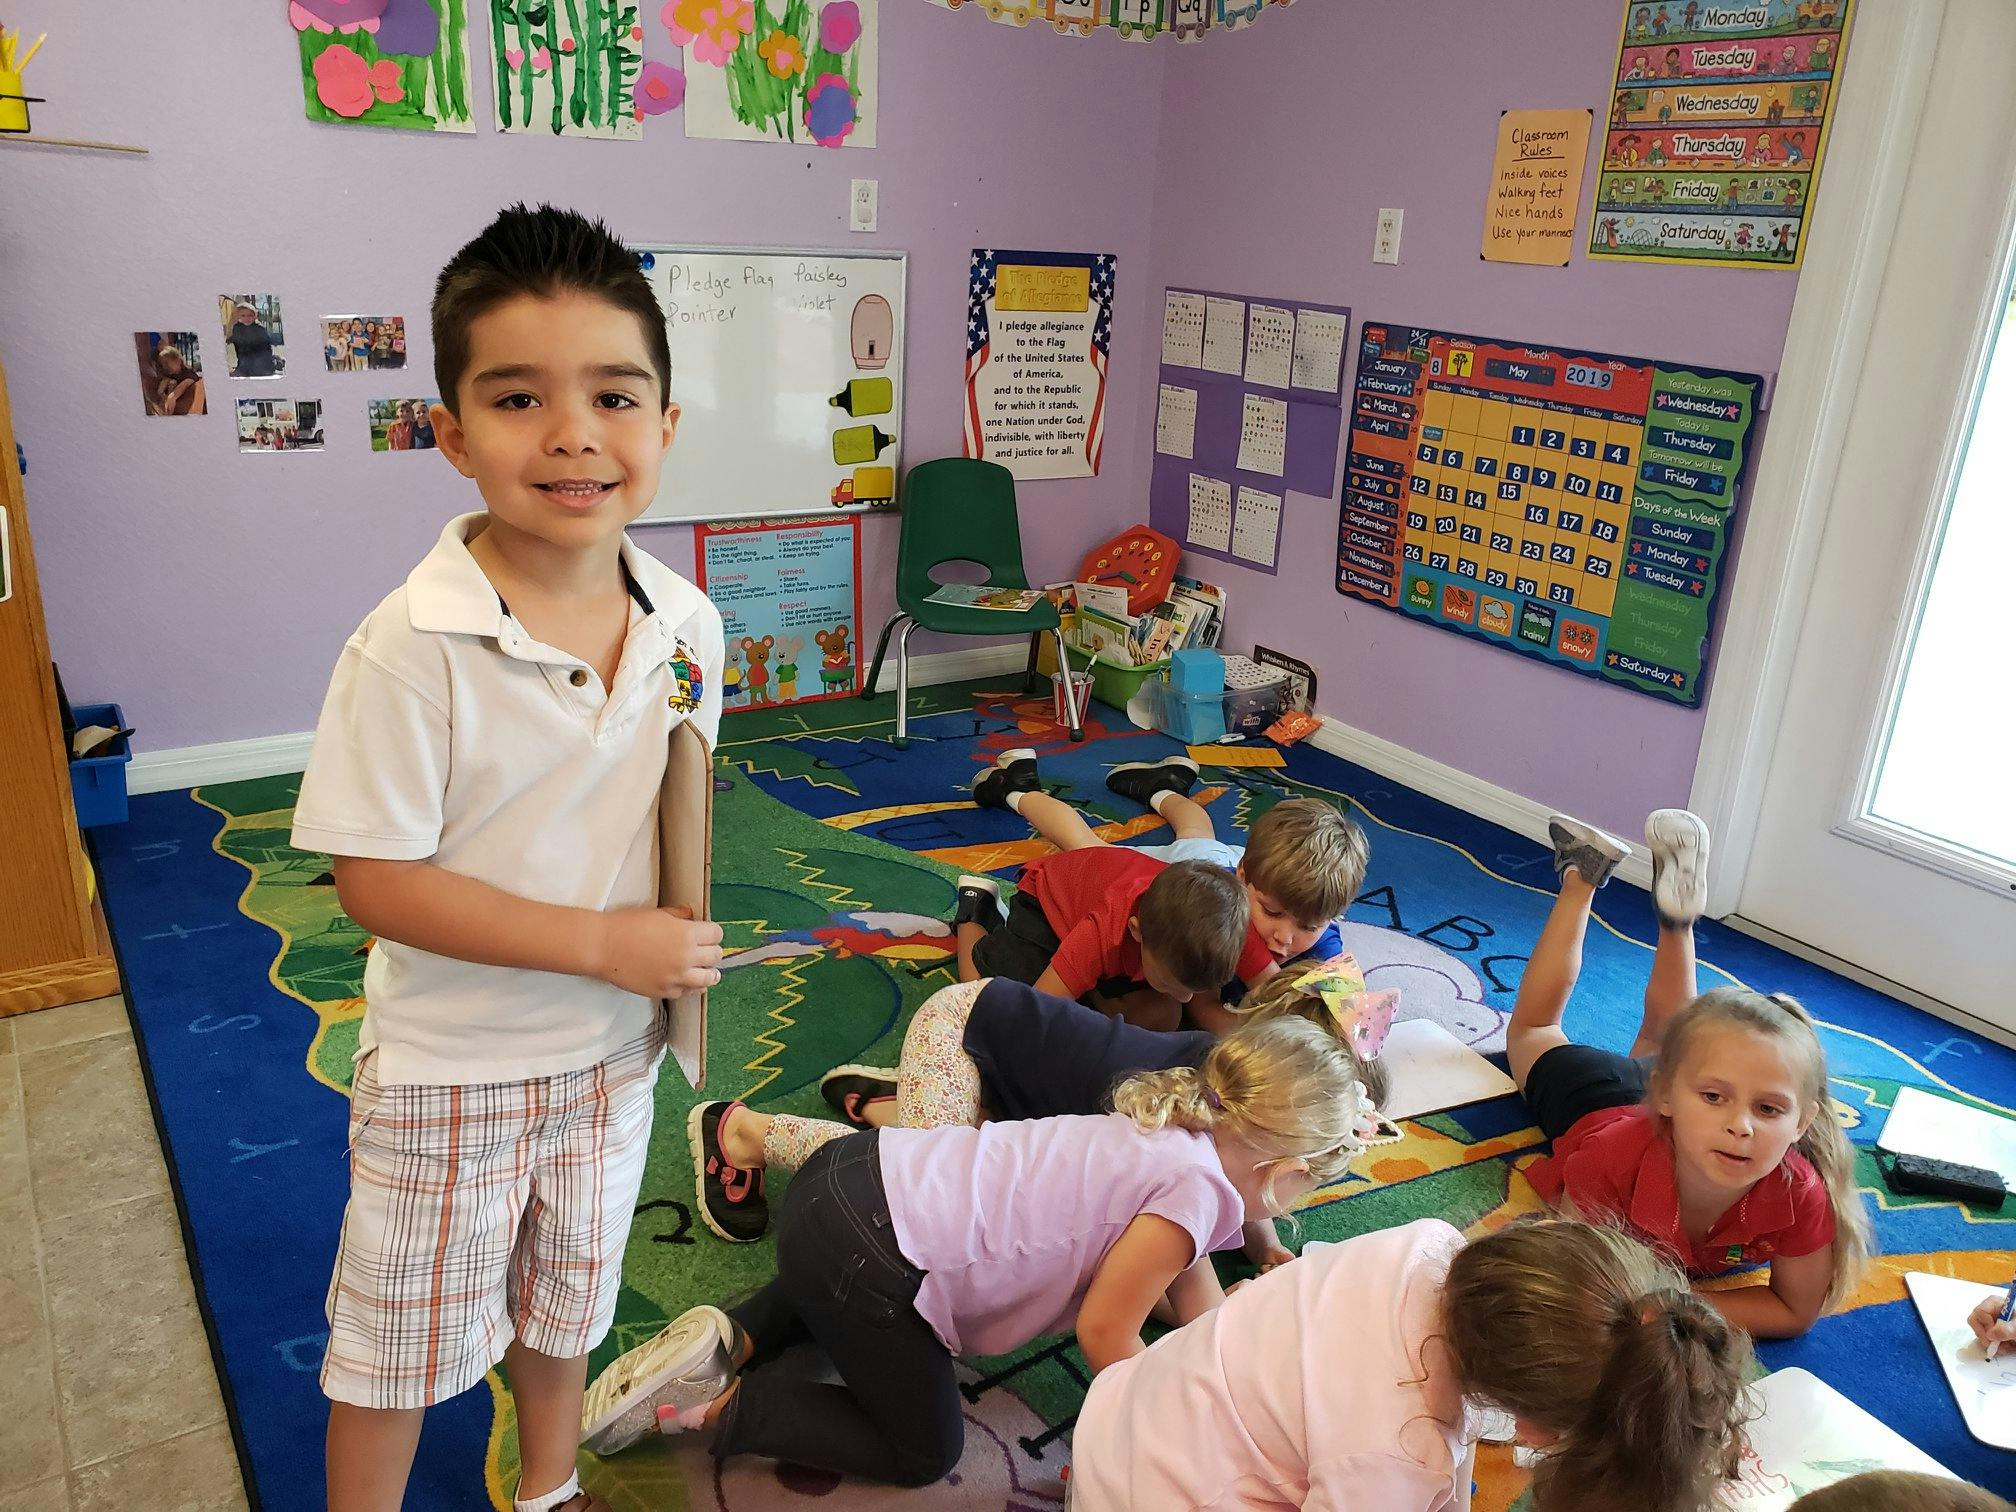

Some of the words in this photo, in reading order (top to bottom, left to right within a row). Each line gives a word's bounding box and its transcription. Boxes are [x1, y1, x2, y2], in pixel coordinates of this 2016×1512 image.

[1704, 9, 1766, 27] Monday
[1693, 50, 1754, 67] Tuesday
[1677, 96, 1759, 114] Wednesday
[1512, 129, 1568, 143] Classroom
[1520, 144, 1552, 158] Rules
[1675, 137, 1744, 156] Thursday
[1501, 168, 1532, 180] Inside
[1539, 168, 1567, 178] voices
[1499, 186, 1535, 204] Walking
[1540, 183, 1563, 198] feet
[1673, 182, 1719, 201] Friday
[1496, 208, 1520, 218] Nice
[1526, 206, 1563, 219] hands
[1493, 226, 1511, 239] Use
[1517, 229, 1536, 244] your
[1661, 222, 1725, 244] Saturday
[670, 265, 731, 298] Pledge
[794, 263, 846, 287] Paisley
[1009, 270, 1031, 284] The
[1036, 271, 1078, 288] Pledge
[1003, 289, 1016, 302] of
[1020, 289, 1083, 305] Allegiance
[666, 302, 736, 327] Pointer
[999, 321, 1003, 330] I
[1006, 321, 1036, 333] pledge
[1040, 321, 1084, 333] allegiance
[1016, 338, 1025, 346] to
[1029, 338, 1043, 346] the
[1047, 338, 1065, 348] Flag
[1450, 338, 1476, 350] Season
[995, 354, 1003, 362] of
[1007, 353, 1022, 362] the
[1025, 353, 1054, 362] United
[1058, 354, 1084, 362] States
[1524, 348, 1550, 360] Month
[1013, 369, 1022, 378] of
[1026, 370, 1063, 379] America,
[1375, 361, 1406, 375] January
[1431, 360, 1440, 374] 8
[1509, 365, 1529, 380] May
[1608, 360, 1626, 372] Year
[1566, 367, 1611, 387] 2019
[994, 386, 1011, 395] and
[1015, 386, 1023, 394] to
[1026, 386, 1041, 394] the
[1044, 385, 1081, 396] Republic
[1368, 378, 1402, 394] February
[1668, 378, 1712, 395] Yesterday
[1713, 387, 1732, 396] was
[995, 402, 1007, 411] for
[1011, 401, 1036, 410] which
[1039, 401, 1045, 410] it
[1049, 401, 1079, 411] stands,
[1374, 399, 1398, 413] March
[1433, 382, 1452, 392] Sunday
[1460, 387, 1480, 397] Monday
[1489, 391, 1510, 403] Tuesday
[1514, 396, 1545, 408] Wednesday
[1547, 402, 1574, 413] Thursday
[1584, 408, 1603, 418] Friday
[1613, 414, 1642, 425] Saturday
[1668, 395, 1728, 418] Wednesday
[1006, 417, 1034, 426] Nation
[1038, 416, 1063, 425] under
[1067, 415, 1085, 425] God,
[1371, 420, 1389, 433] April
[1676, 417, 1700, 432] Today
[1703, 422, 1710, 432] is
[985, 432, 1030, 443] indivisible,
[1035, 432, 1054, 441] with
[1058, 431, 1085, 441] liberty
[1520, 429, 1526, 442] 1
[1547, 433, 1556, 447] 2
[1578, 442, 1587, 455] 3
[1611, 448, 1621, 462] 4
[1663, 431, 1716, 454] Thursday
[996, 448, 1012, 457] and
[1015, 448, 1043, 459] justice
[1047, 447, 1058, 456] for
[1062, 446, 1074, 455] all.
[1648, 450, 1693, 466] Tomorrow
[1695, 460, 1710, 469] will
[1712, 462, 1723, 472] be
[1366, 459, 1384, 472] June
[1423, 447, 1432, 461] 5
[1448, 452, 1456, 465] 6
[1481, 459, 1491, 472] 7
[1512, 466, 1521, 480] 8
[1540, 471, 1548, 485] 9
[1568, 478, 1585, 494] 10
[1600, 484, 1615, 501] 11
[1364, 480, 1380, 492] July
[1665, 468, 1698, 488] Friday
[1357, 495, 1384, 511] August
[1412, 476, 1426, 493] 12
[1440, 486, 1453, 501] 13
[1468, 492, 1483, 508] 14
[1501, 484, 1516, 499] 15
[1528, 507, 1544, 523] 16
[1562, 513, 1579, 530] 17
[1595, 522, 1613, 540] 18
[1634, 496, 1661, 514] Days
[1662, 507, 1672, 516] of
[1674, 508, 1688, 519] the
[1690, 508, 1720, 527] Week
[1349, 512, 1389, 532] September
[776, 530, 824, 540] Responsibility
[1351, 533, 1382, 549] October
[1652, 523, 1693, 543] Sunday
[1410, 514, 1423, 529] 19
[1438, 518, 1454, 532] 20
[1462, 527, 1476, 542] 21
[1491, 535, 1509, 551] 22
[1522, 543, 1540, 559] 23
[1552, 546, 1571, 562] 24
[1587, 558, 1607, 576] 25
[1349, 551, 1384, 571] November
[1647, 545, 1689, 567] Monday
[777, 568, 805, 576] Fairness
[1404, 545, 1420, 560] 26
[1431, 554, 1447, 569] 27
[1458, 560, 1475, 576] 28
[1487, 571, 1504, 587] 29
[1516, 579, 1535, 596] 30
[1552, 587, 1568, 602] 31
[1643, 566, 1685, 590] Tuesday
[1348, 572, 1382, 590] December
[779, 601, 807, 610] Respect
[1411, 594, 1432, 608] sunny
[1627, 586, 1691, 615] Wednesday
[1447, 605, 1469, 619] windy
[1481, 615, 1508, 632] cloudy
[1630, 612, 1682, 638] Thursday
[1523, 629, 1546, 643] rainy
[1562, 641, 1592, 658] snowy
[1634, 637, 1669, 658] Friday
[1620, 657, 1670, 683] Saturday
[1243, 716, 1260, 726] with
[1417, 914, 1496, 953] B
